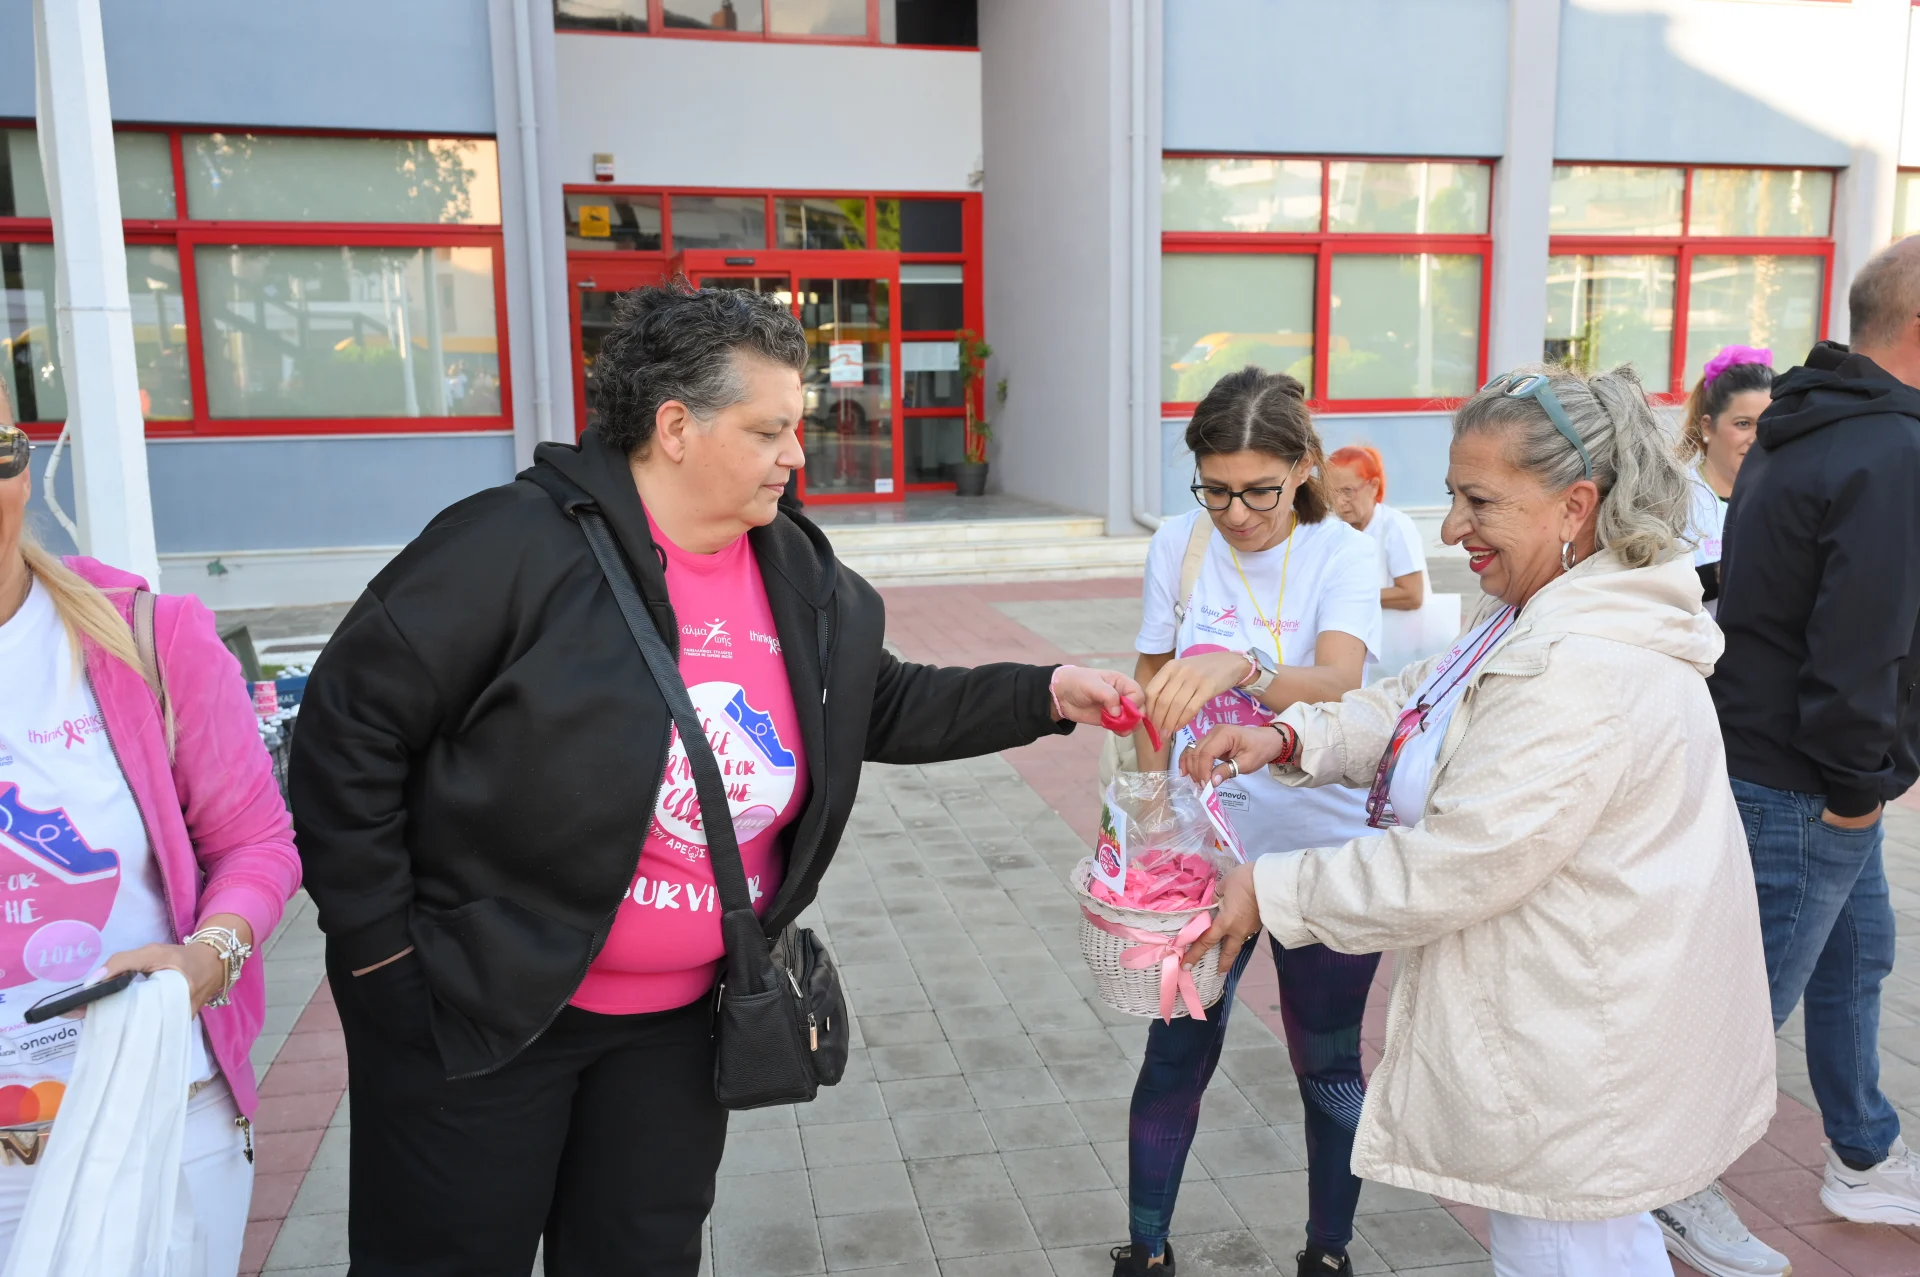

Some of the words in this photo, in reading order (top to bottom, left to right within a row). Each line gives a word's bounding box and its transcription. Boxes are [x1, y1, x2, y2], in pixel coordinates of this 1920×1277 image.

[682, 624, 708, 637] άλμα
[724, 760, 755, 775] FOR
[624, 875, 763, 913] URVIR
[0, 898, 44, 924] HE
[38, 941, 93, 968] 2026
[20, 1028, 78, 1051] onavda
